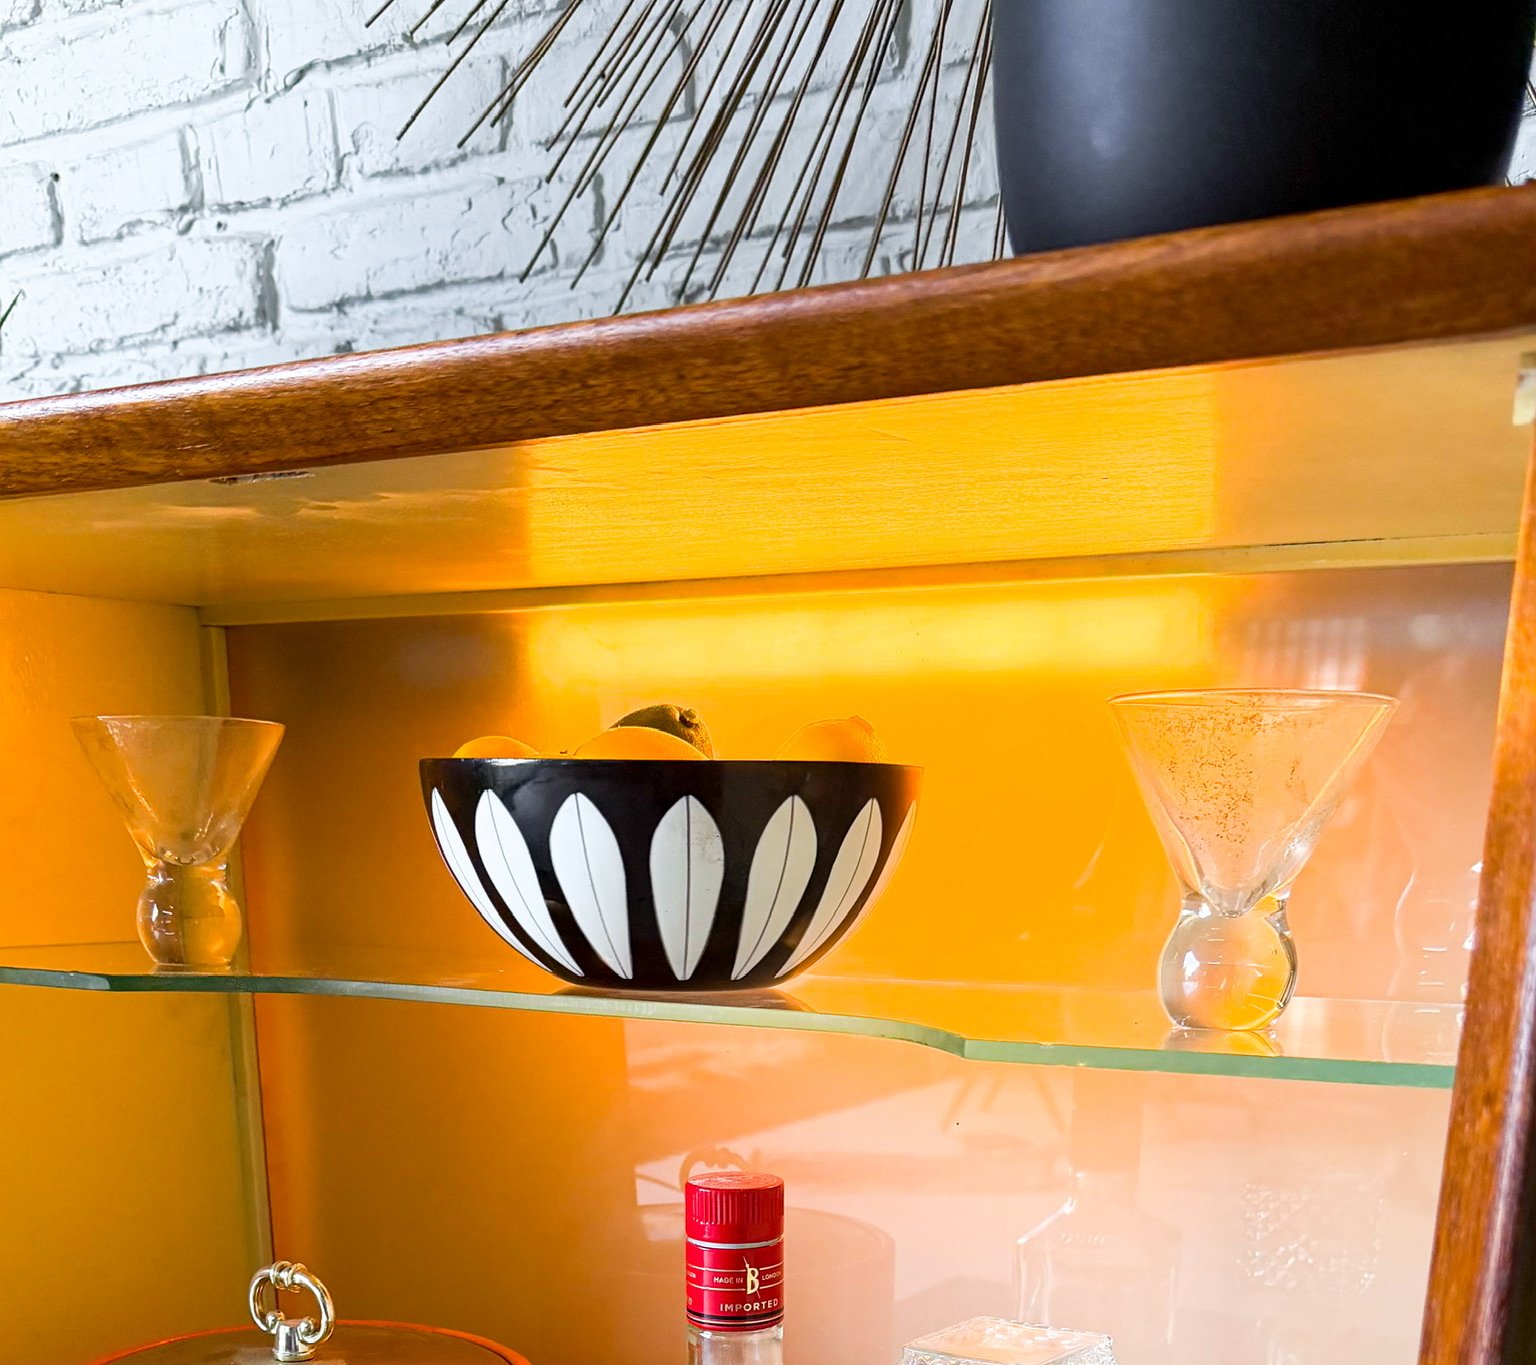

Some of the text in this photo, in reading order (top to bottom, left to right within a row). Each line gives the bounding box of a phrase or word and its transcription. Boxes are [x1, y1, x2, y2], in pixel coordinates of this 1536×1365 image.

[713, 1276, 735, 1284] MADE
[746, 1267, 760, 1295] B
[719, 1298, 779, 1312] IMPORTED
